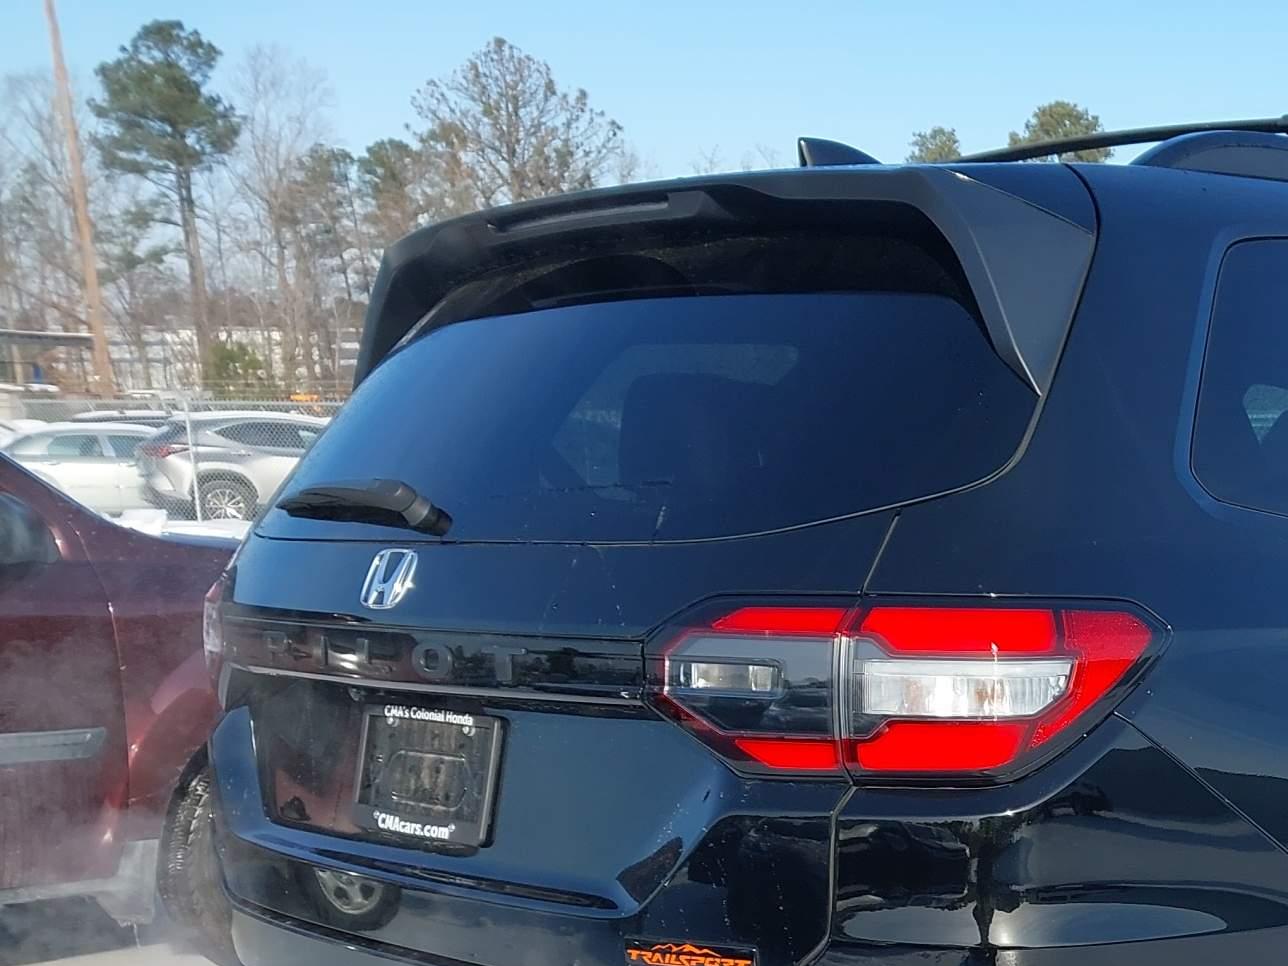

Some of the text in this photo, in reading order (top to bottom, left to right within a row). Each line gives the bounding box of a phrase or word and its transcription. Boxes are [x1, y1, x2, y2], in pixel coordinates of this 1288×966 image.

[264, 630, 527, 683] PILOT
[384, 704, 474, 726] CMA's Colonial Honda
[377, 812, 451, 840] CMAcars.com
